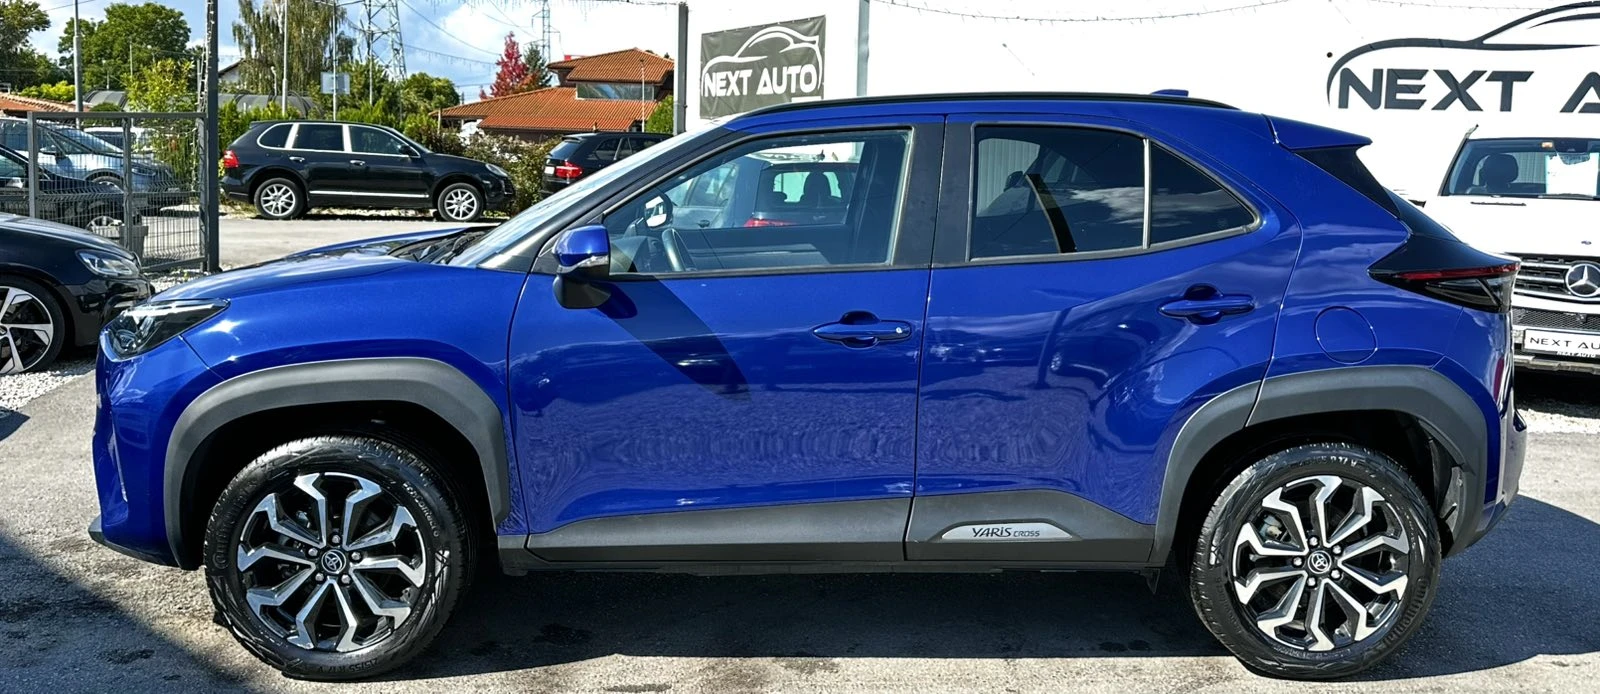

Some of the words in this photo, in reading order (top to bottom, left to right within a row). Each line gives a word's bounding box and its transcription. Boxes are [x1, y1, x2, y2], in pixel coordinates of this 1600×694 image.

[704, 69, 753, 97] NEXT
[756, 63, 818, 95] AUTO
[1338, 67, 1535, 112] NEXT
[1530, 337, 1572, 347] NEXT
[1577, 341, 1600, 350] AU
[1013, 530, 1040, 538] CROSS
